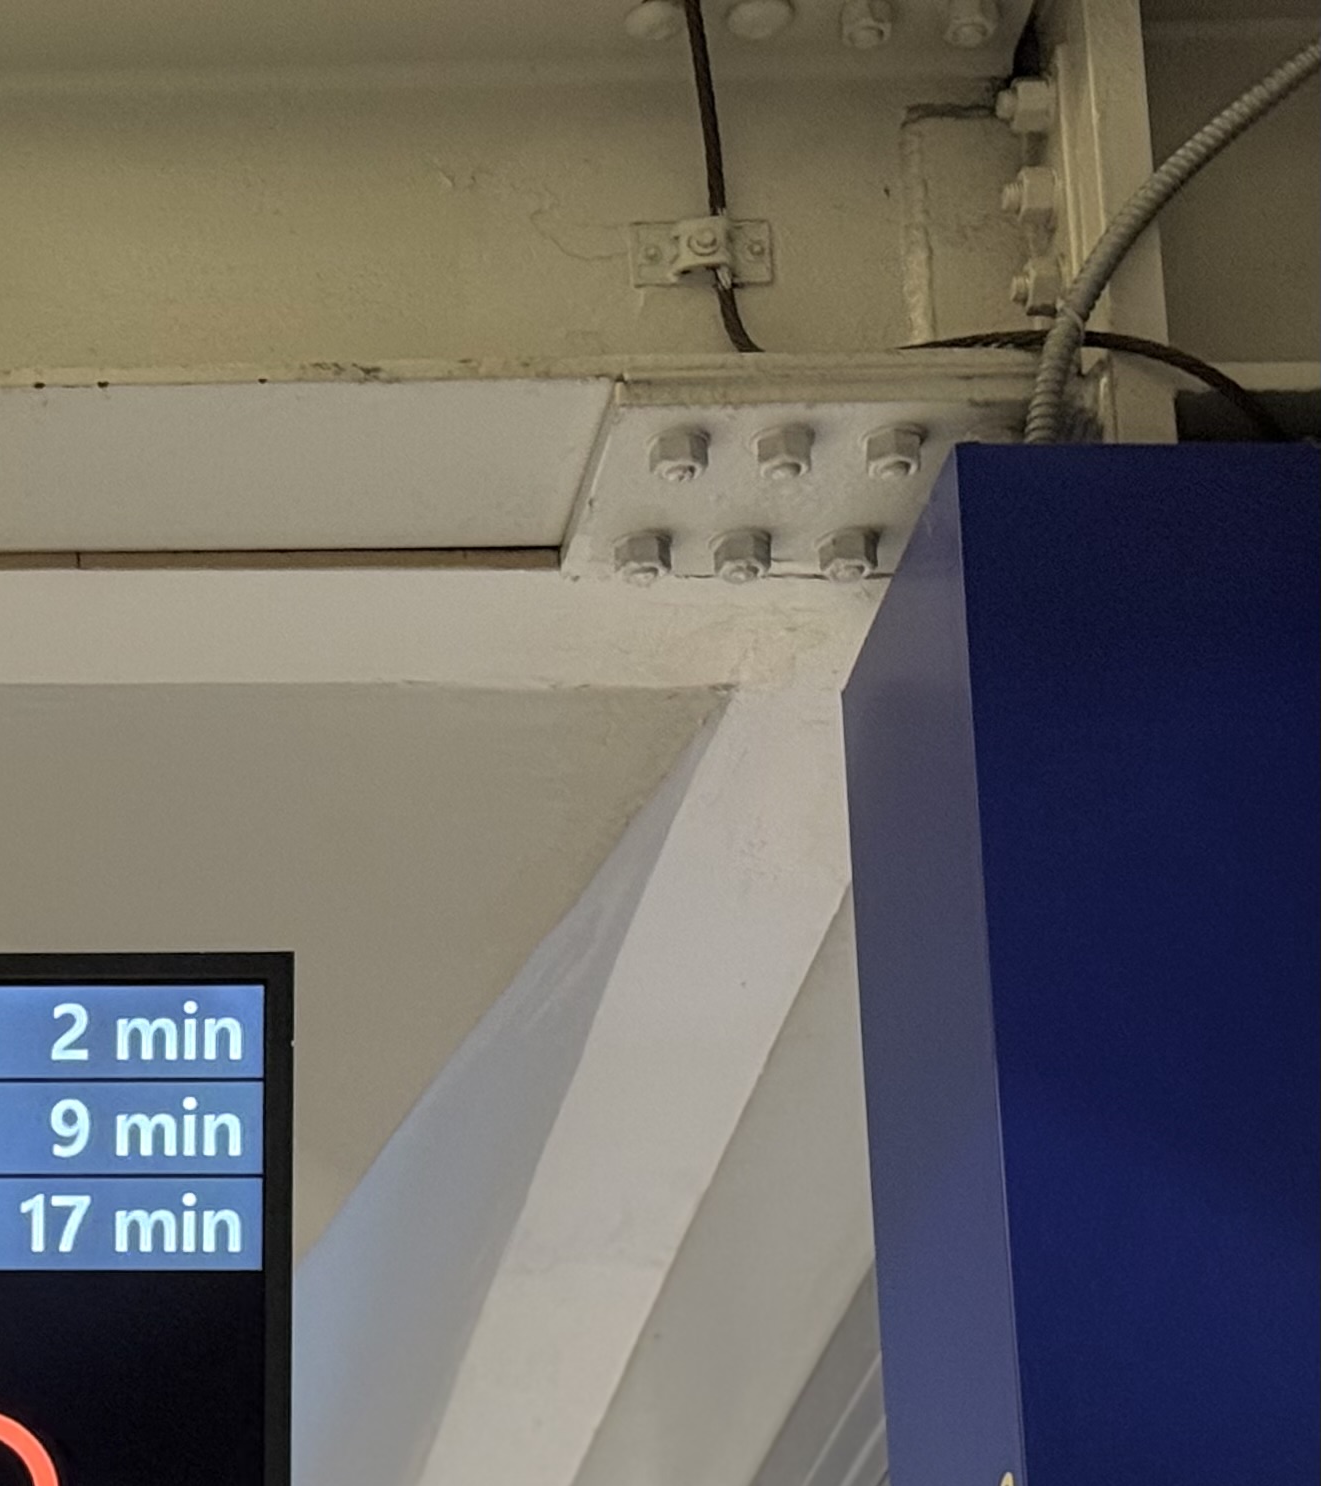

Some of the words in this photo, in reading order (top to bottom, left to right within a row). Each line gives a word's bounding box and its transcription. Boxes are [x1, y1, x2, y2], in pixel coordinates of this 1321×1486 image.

[51, 1003, 89, 1061] 2
[116, 1000, 242, 1061] min
[50, 1098, 90, 1158] 9
[115, 1096, 242, 1157] min
[20, 1193, 91, 1253] 17
[115, 1192, 241, 1253] min
